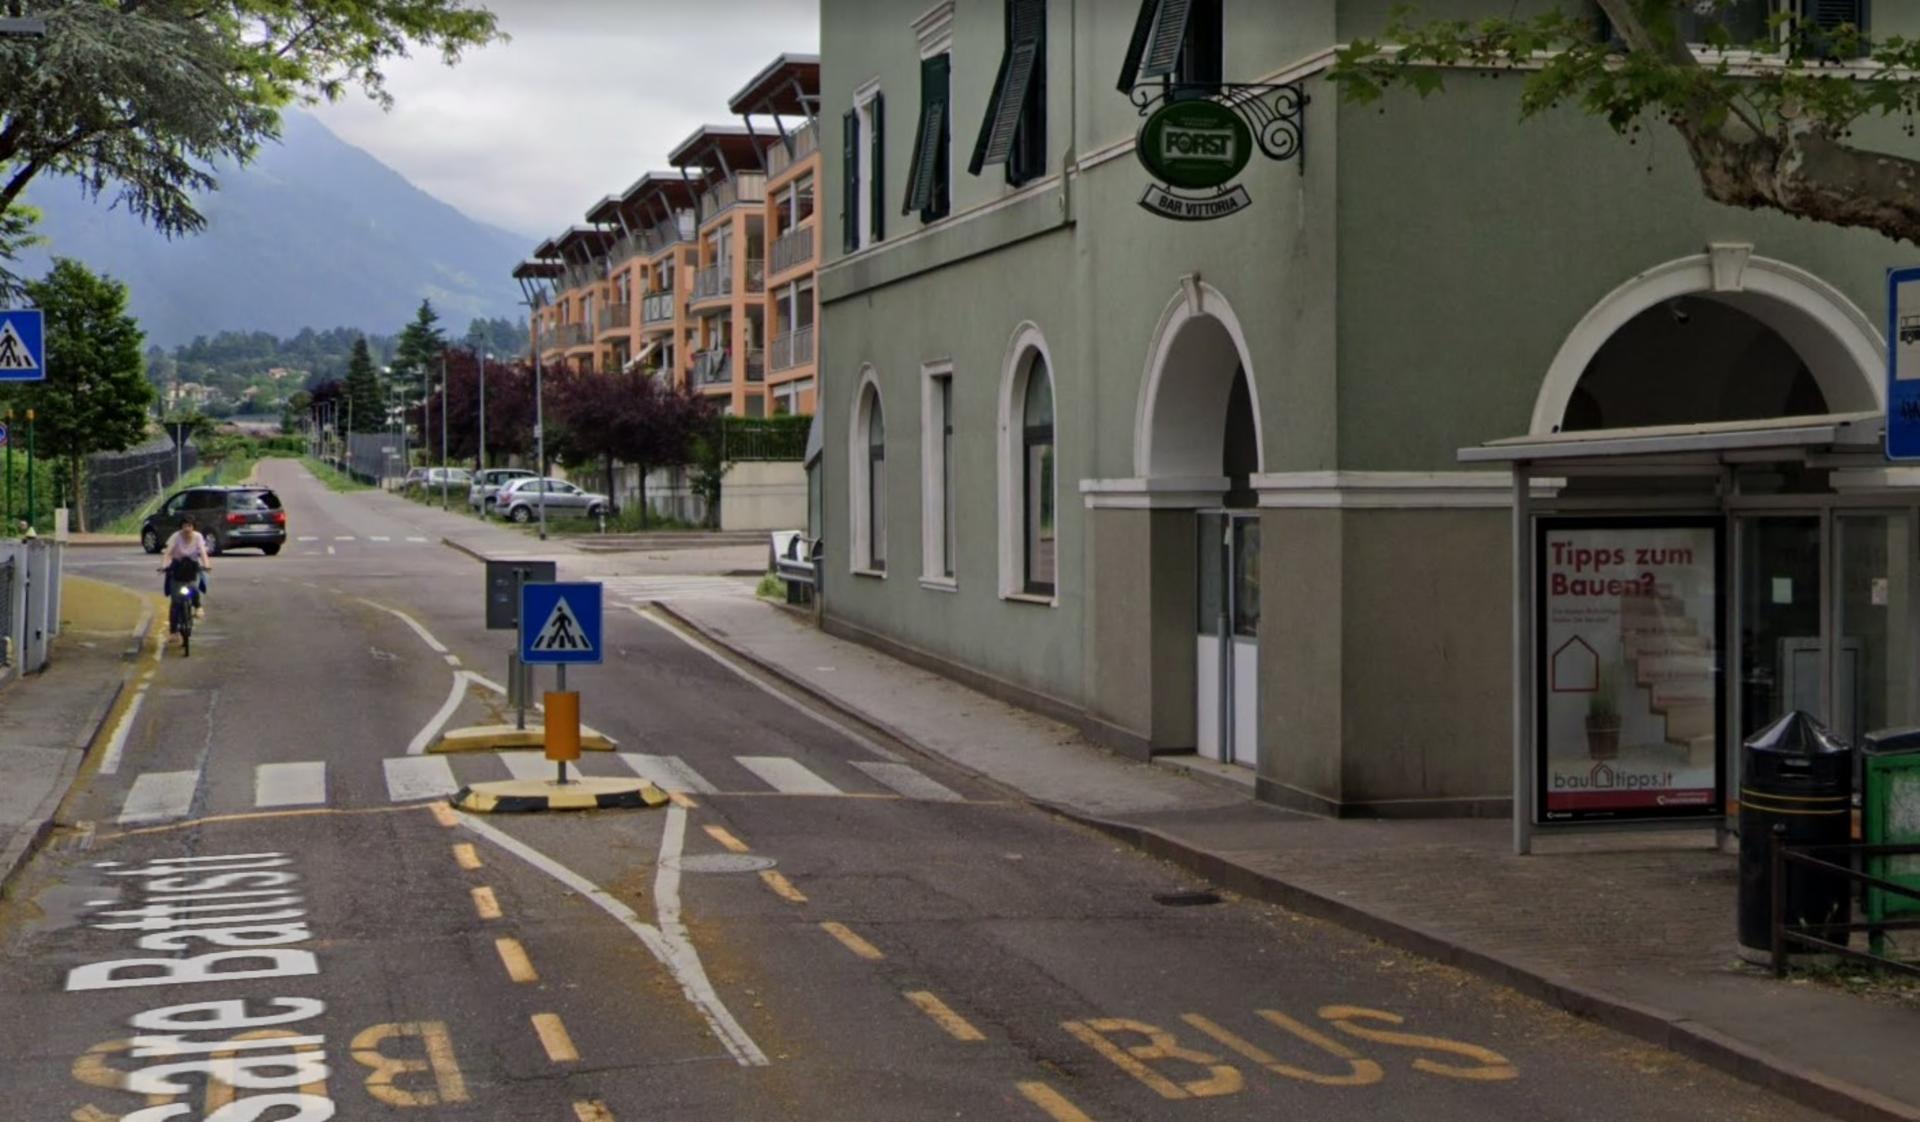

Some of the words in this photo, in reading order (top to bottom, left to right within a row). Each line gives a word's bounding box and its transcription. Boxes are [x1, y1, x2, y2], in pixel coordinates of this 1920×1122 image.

[1166, 132, 1231, 155] FORST
[1159, 196, 1182, 213] BAR
[1186, 197, 1238, 216] VITTORIA
[1552, 541, 1625, 572] Tipps
[1636, 549, 1693, 565] zum
[1552, 572, 1655, 596] Bauen?
[1062, 1005, 1519, 1099] BUS
